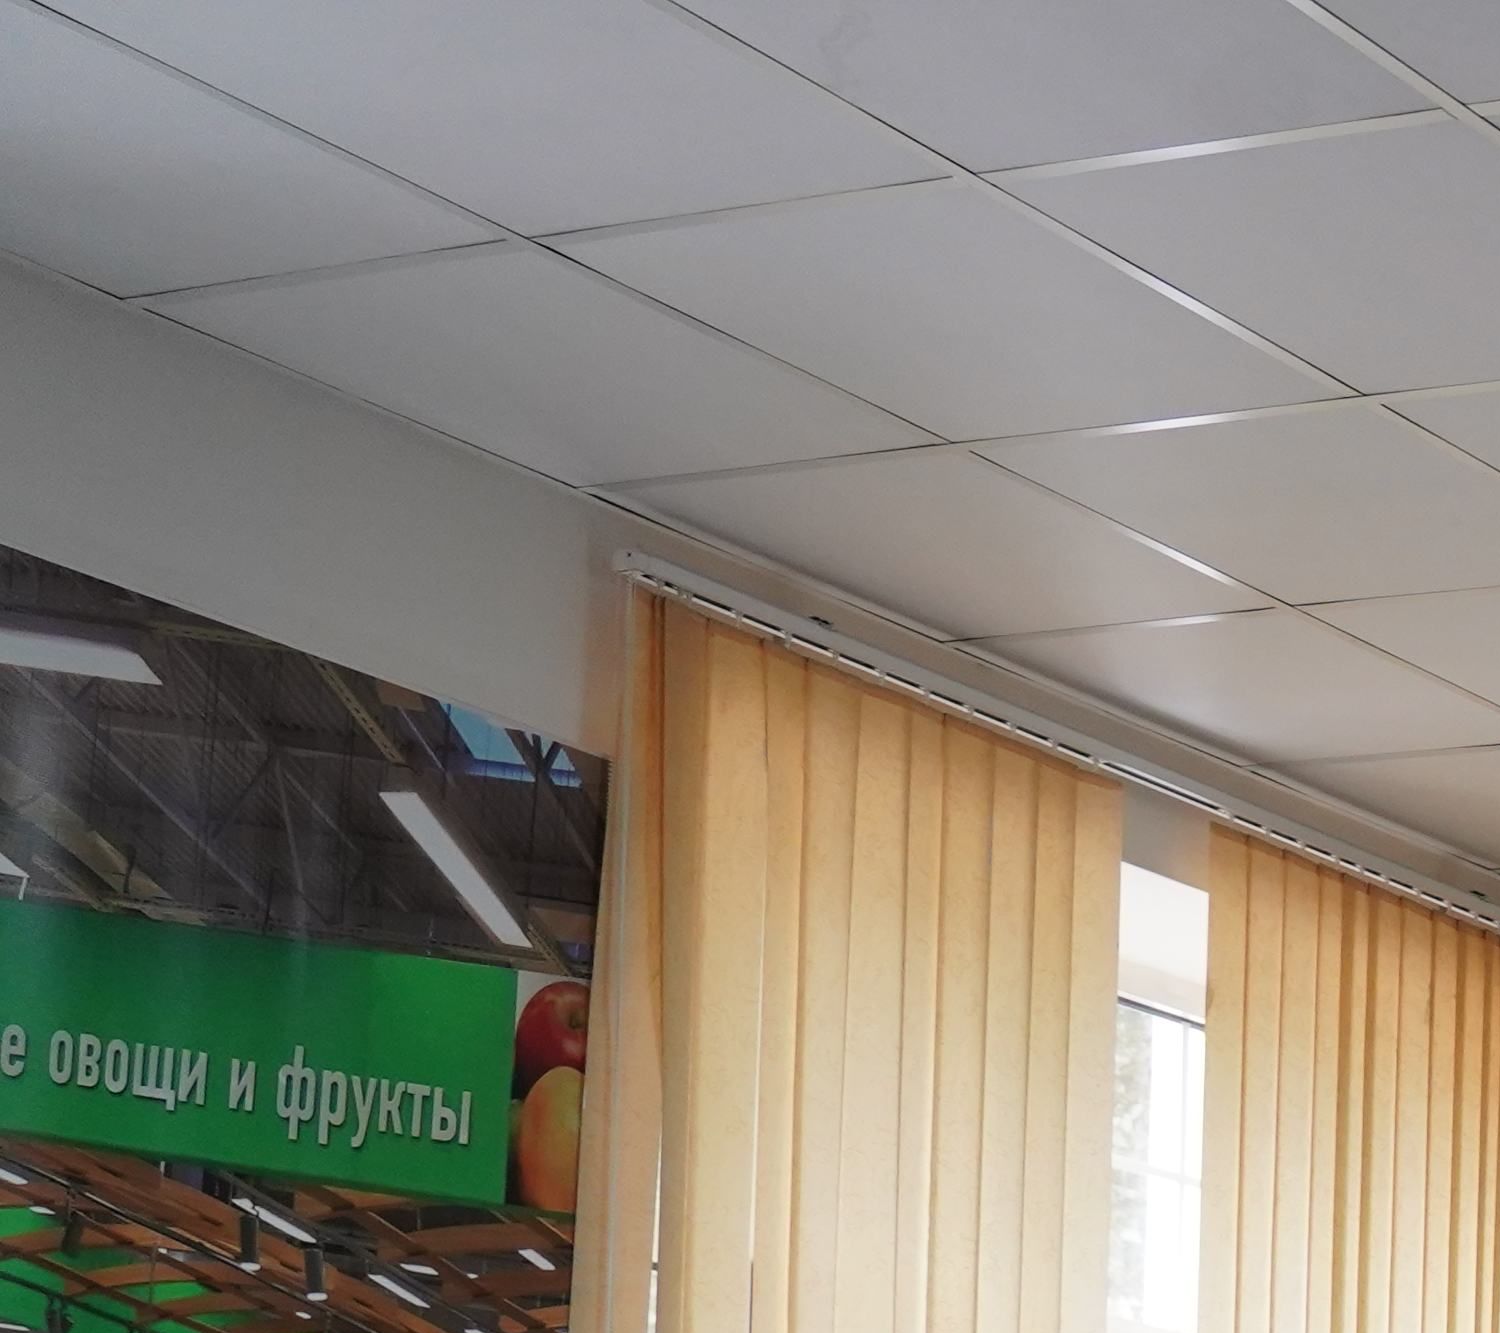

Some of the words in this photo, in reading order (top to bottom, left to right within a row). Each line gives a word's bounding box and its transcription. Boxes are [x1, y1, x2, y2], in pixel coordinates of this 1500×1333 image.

[49, 1027, 207, 1110] овощи
[229, 1055, 255, 1113] и
[276, 1045, 473, 1148] фрукты
